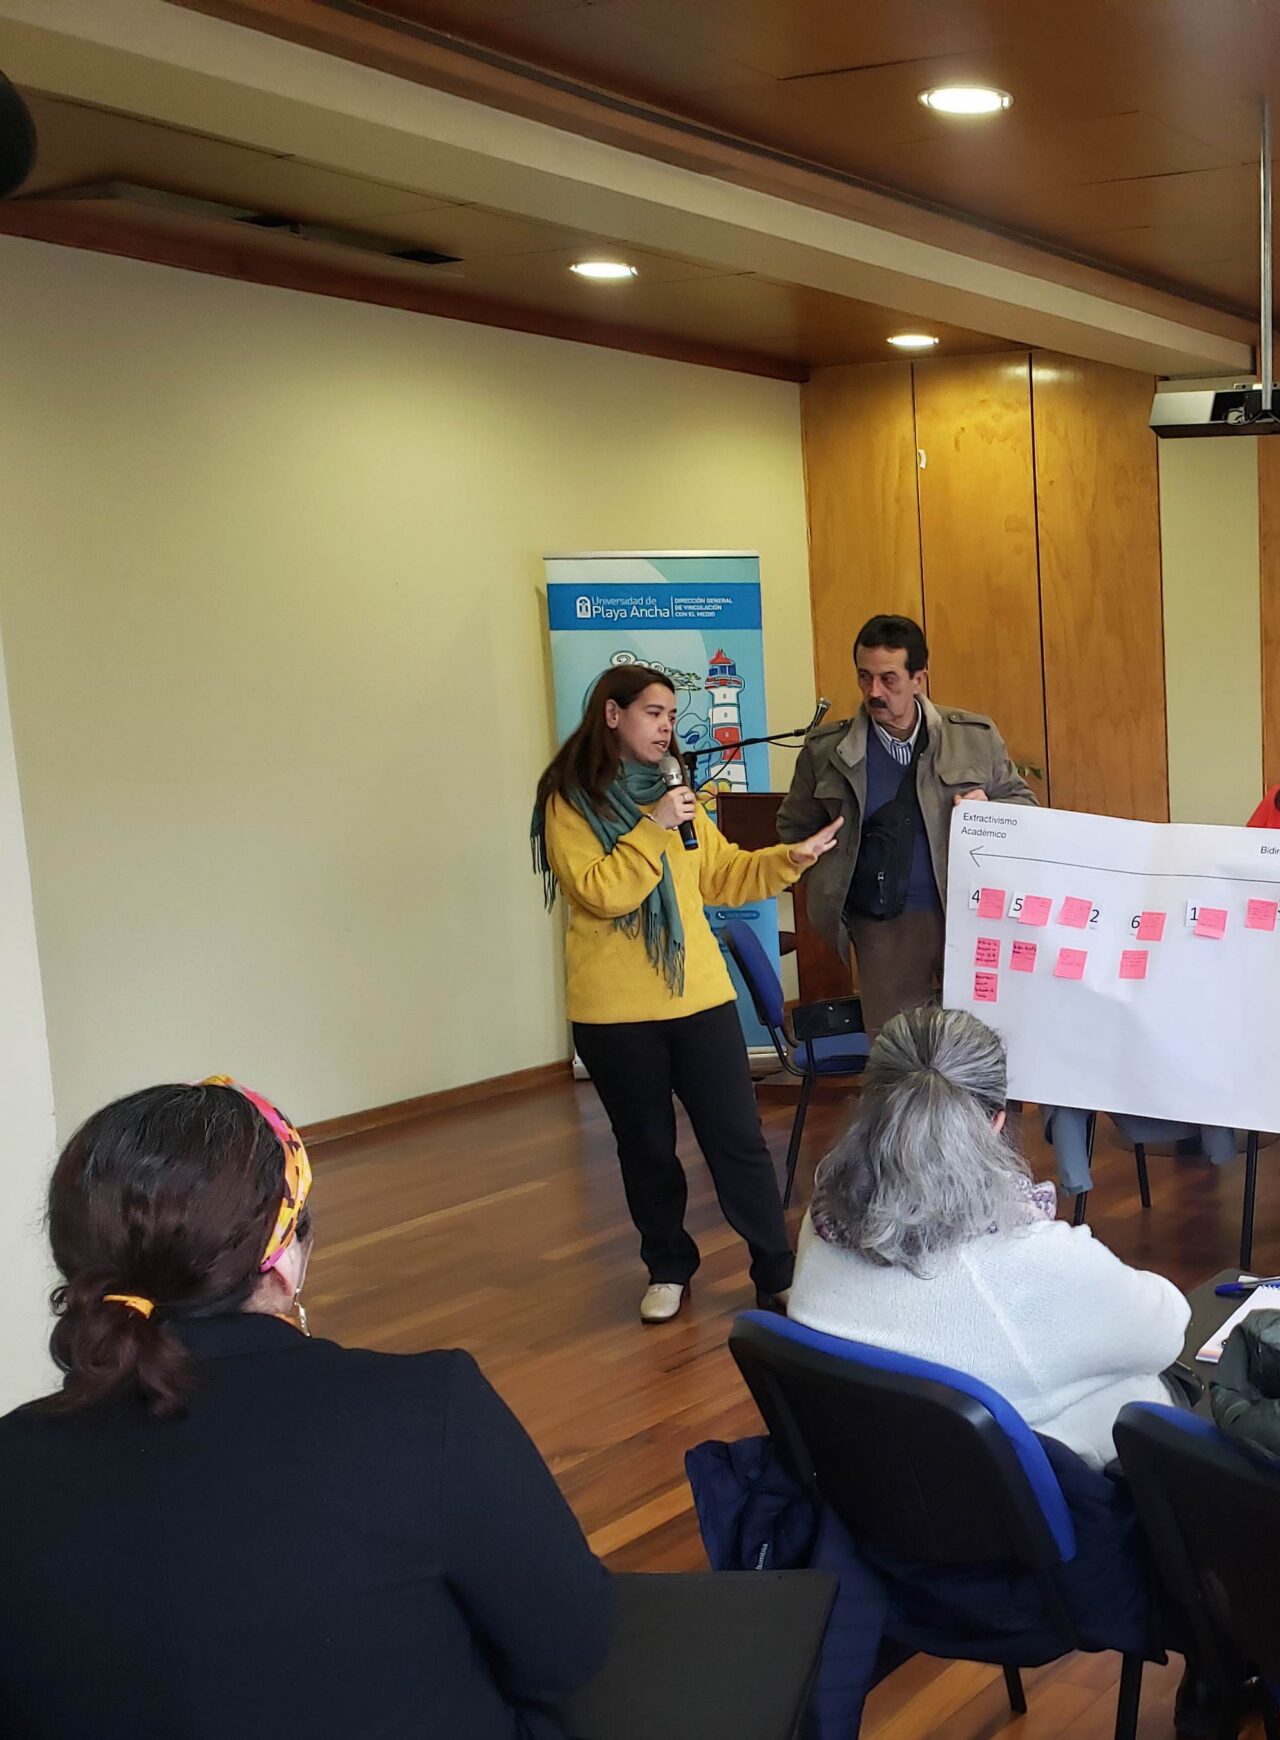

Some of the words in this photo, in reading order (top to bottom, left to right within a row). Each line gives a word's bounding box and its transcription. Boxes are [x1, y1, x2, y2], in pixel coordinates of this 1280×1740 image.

[592, 596, 643, 605] Universidad
[646, 597, 656, 605] de
[593, 606, 627, 621] Playa
[630, 605, 670, 617] Ancha
[963, 813, 1018, 826] Extractivismo
[961, 826, 1006, 838] Académico
[972, 890, 980, 904] 4
[1013, 898, 1023, 912] 5
[1090, 909, 1100, 923] 2
[1190, 907, 1198, 921] 1
[1131, 916, 1140, 929] 6
[754, 1543, 768, 1570] lumbia
